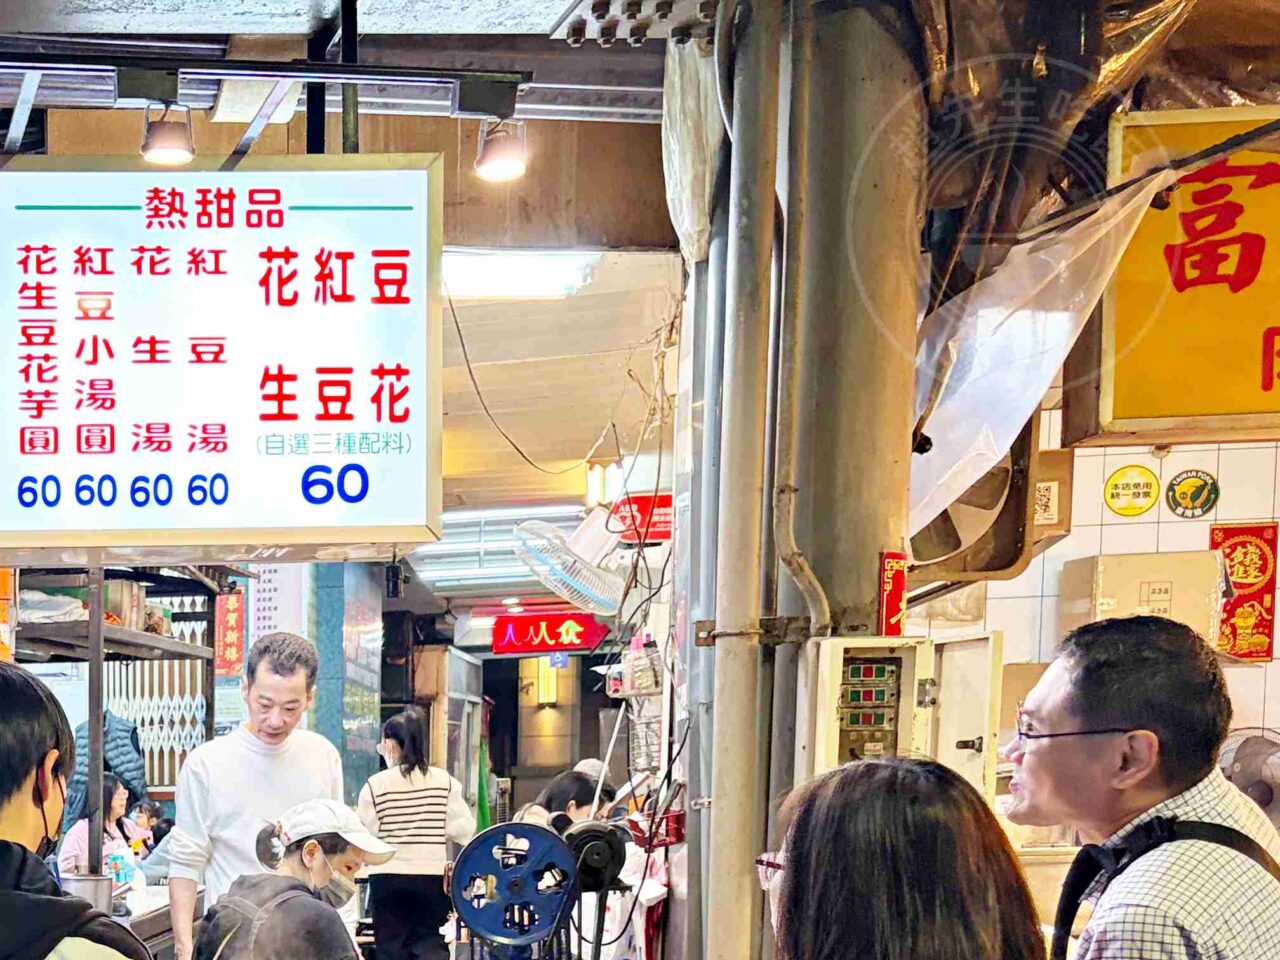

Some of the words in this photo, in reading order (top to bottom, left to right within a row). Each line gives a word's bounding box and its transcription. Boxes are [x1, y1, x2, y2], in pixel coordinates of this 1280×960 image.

[146, 187, 284, 229] 熱甜品
[1160, 150, 1280, 296] 富
[17, 245, 59, 455] 花生豆花芋圓
[74, 245, 116, 454] 紅豆小湯圓
[132, 246, 172, 452] 花生湯
[187, 247, 228, 453] 紅豆湯
[17, 474, 61, 508] 60
[75, 474, 117, 507] 60
[130, 473, 173, 508] 60
[187, 473, 229, 506] 60
[301, 463, 369, 505] 60
[256, 431, 412, 456] (自選三種配料)
